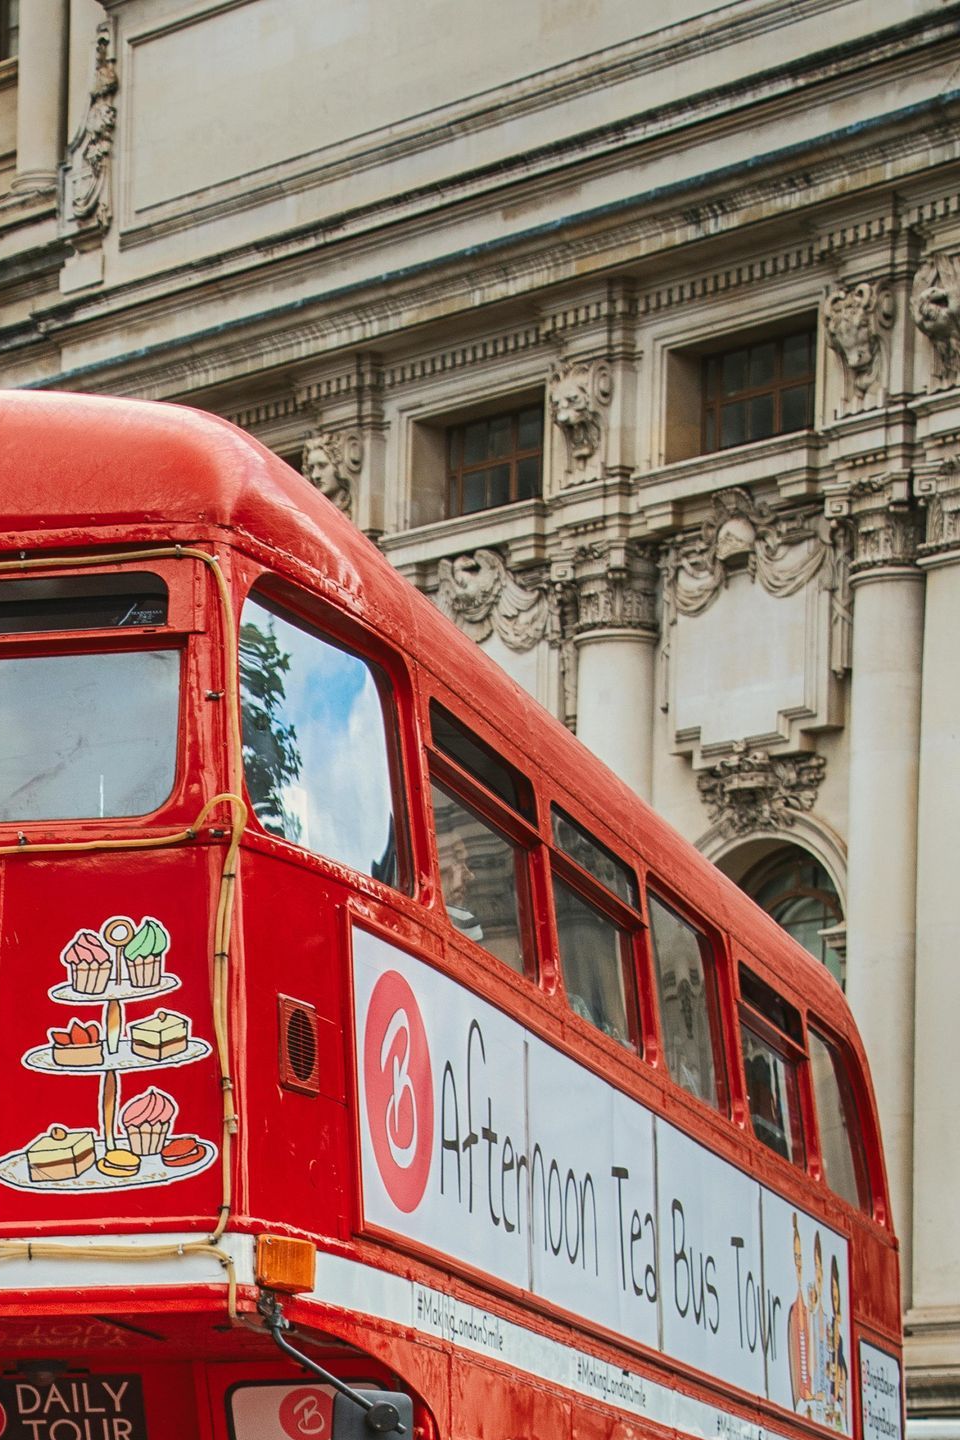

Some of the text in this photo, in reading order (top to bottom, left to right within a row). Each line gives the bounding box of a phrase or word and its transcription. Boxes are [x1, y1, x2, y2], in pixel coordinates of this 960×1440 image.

[440, 1019, 781, 1362] Afternoon Tea Bus Tour
[16, 1382, 128, 1414] DAILY
